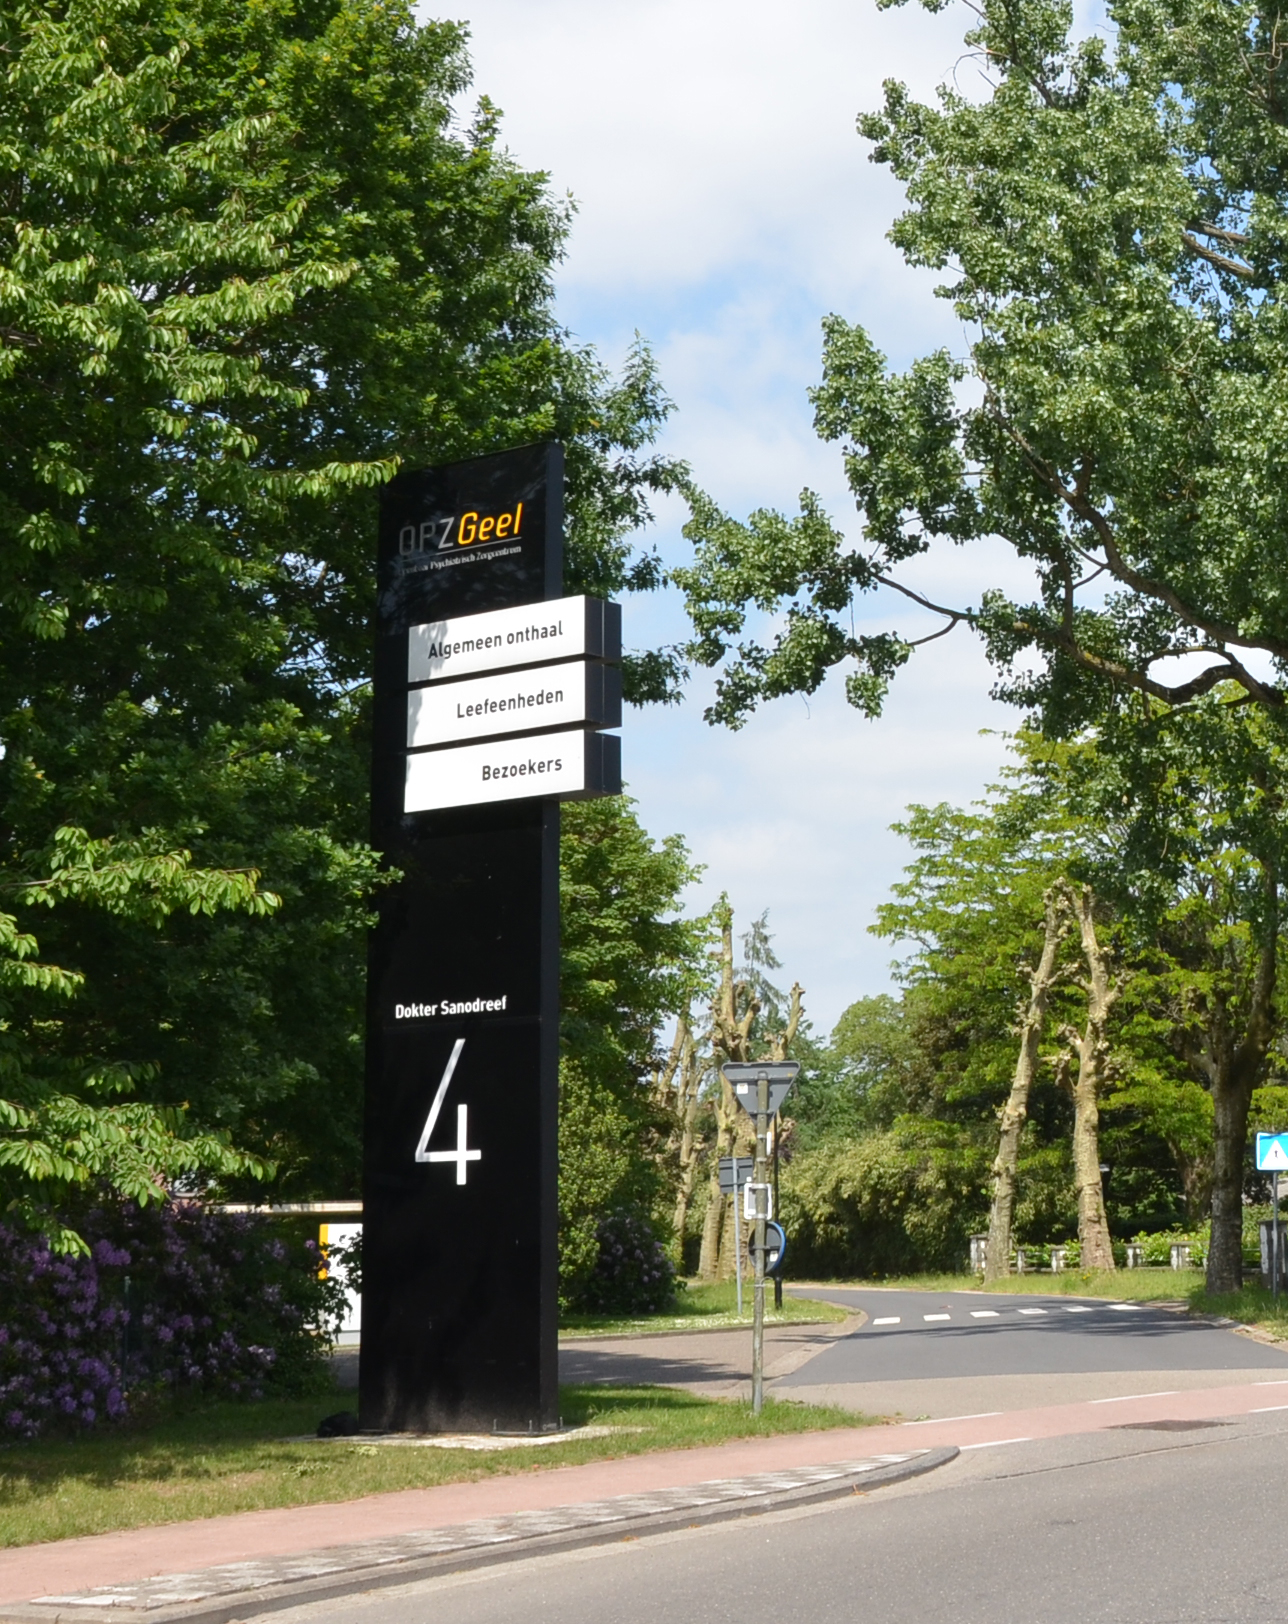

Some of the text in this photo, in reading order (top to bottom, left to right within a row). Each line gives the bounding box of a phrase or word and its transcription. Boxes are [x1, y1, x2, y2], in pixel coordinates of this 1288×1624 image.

[428, 620, 563, 659] Algemeen onthaal
[457, 689, 564, 719] Leefeenheden
[481, 758, 563, 781] Bezoekers
[396, 995, 507, 1019] Dokter Sanodreef
[415, 1038, 482, 1186] 4
